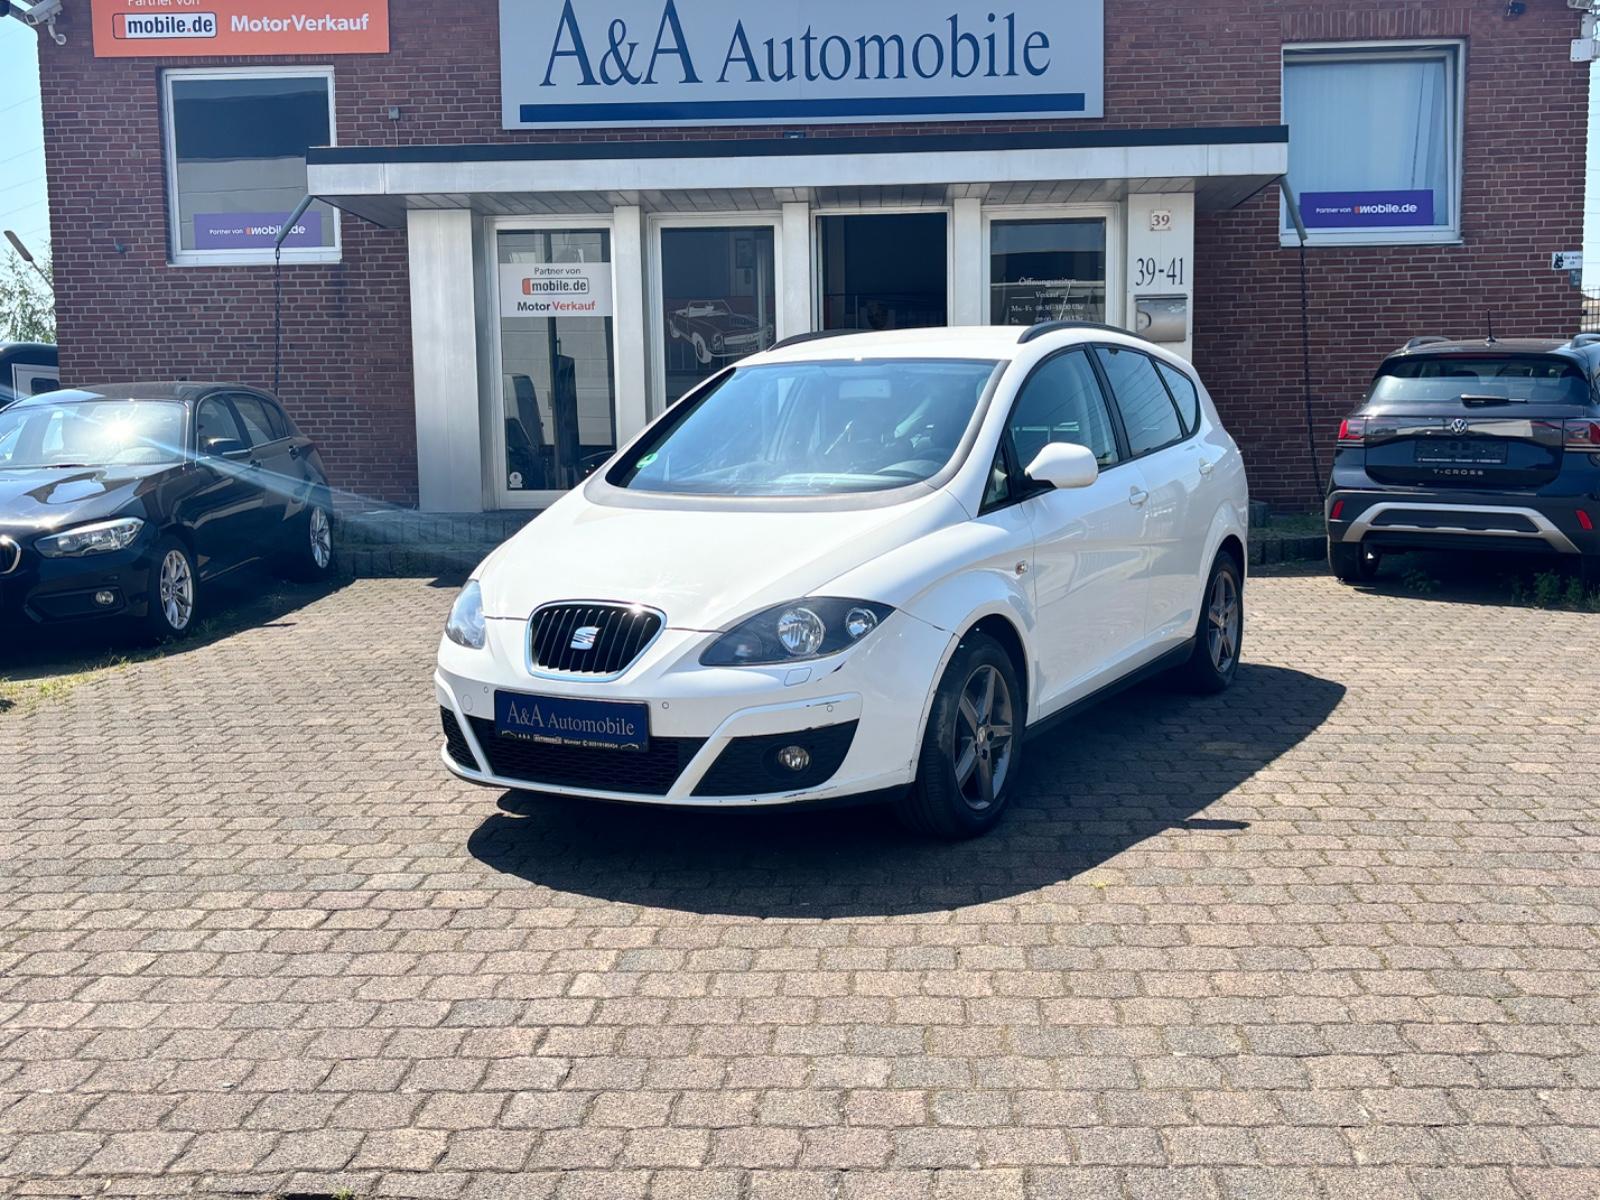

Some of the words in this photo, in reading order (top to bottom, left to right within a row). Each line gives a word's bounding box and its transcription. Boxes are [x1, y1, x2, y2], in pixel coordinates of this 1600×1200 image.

[127, 15, 213, 34] mobile.de
[539, 0, 703, 87] A&A
[718, 12, 1051, 83] Automobile
[1360, 203, 1417, 213] mobile.de
[1152, 214, 1170, 227] 39
[534, 267, 563, 275] Partner
[1135, 256, 1184, 287] 39-41
[532, 280, 586, 291] mobile.de
[507, 700, 545, 728] A&A
[548, 711, 635, 736] Automobile
